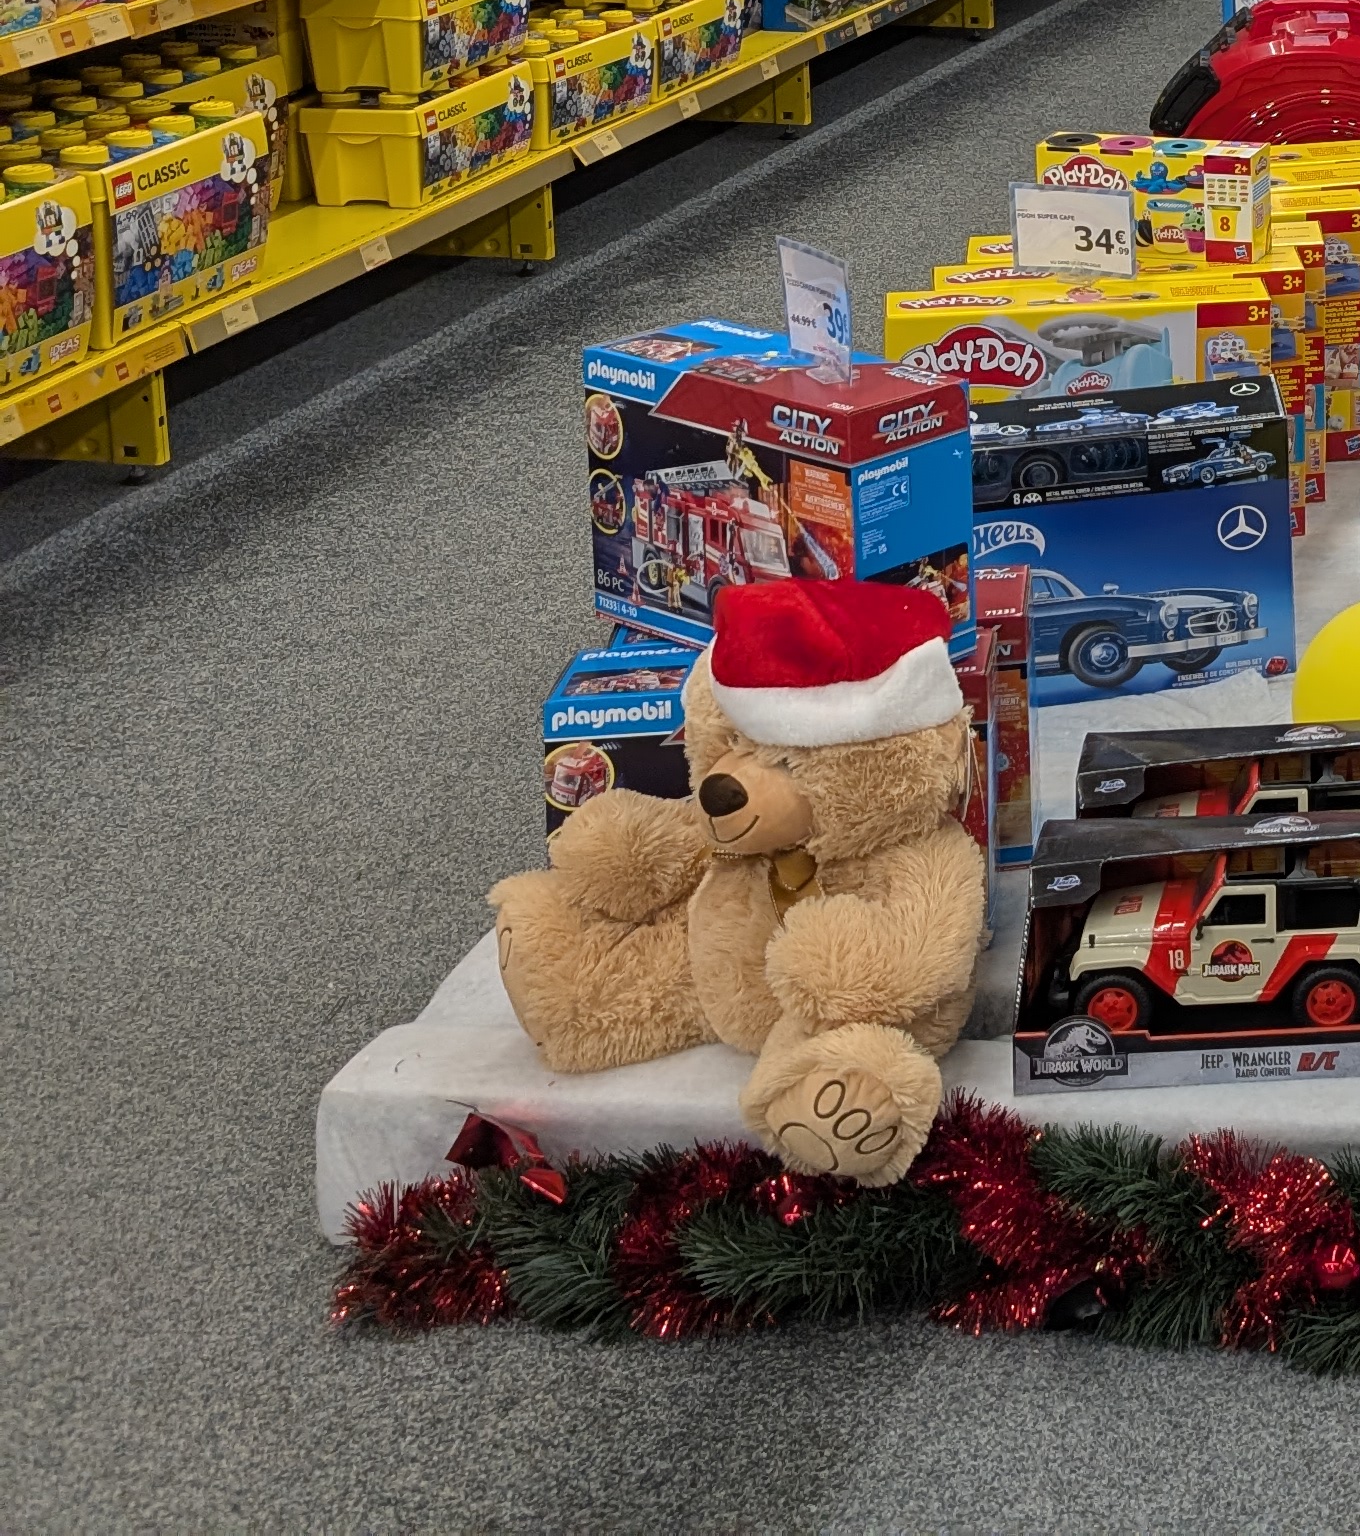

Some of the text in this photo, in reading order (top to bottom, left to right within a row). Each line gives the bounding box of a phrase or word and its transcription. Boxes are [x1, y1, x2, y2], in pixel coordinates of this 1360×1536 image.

[113, 180, 135, 201] LEGO
[901, 336, 1042, 381] Play-Doh
[587, 359, 656, 393] playmobil
[772, 405, 833, 435] CITY
[877, 400, 936, 437] CITY
[885, 414, 944, 445] ACTION
[778, 428, 840, 455] ACTION
[552, 700, 672, 732] playmobil
[1034, 1057, 1125, 1075] JURASSIC WORLD
[1200, 1052, 1292, 1071] JEEP WRANGLER
